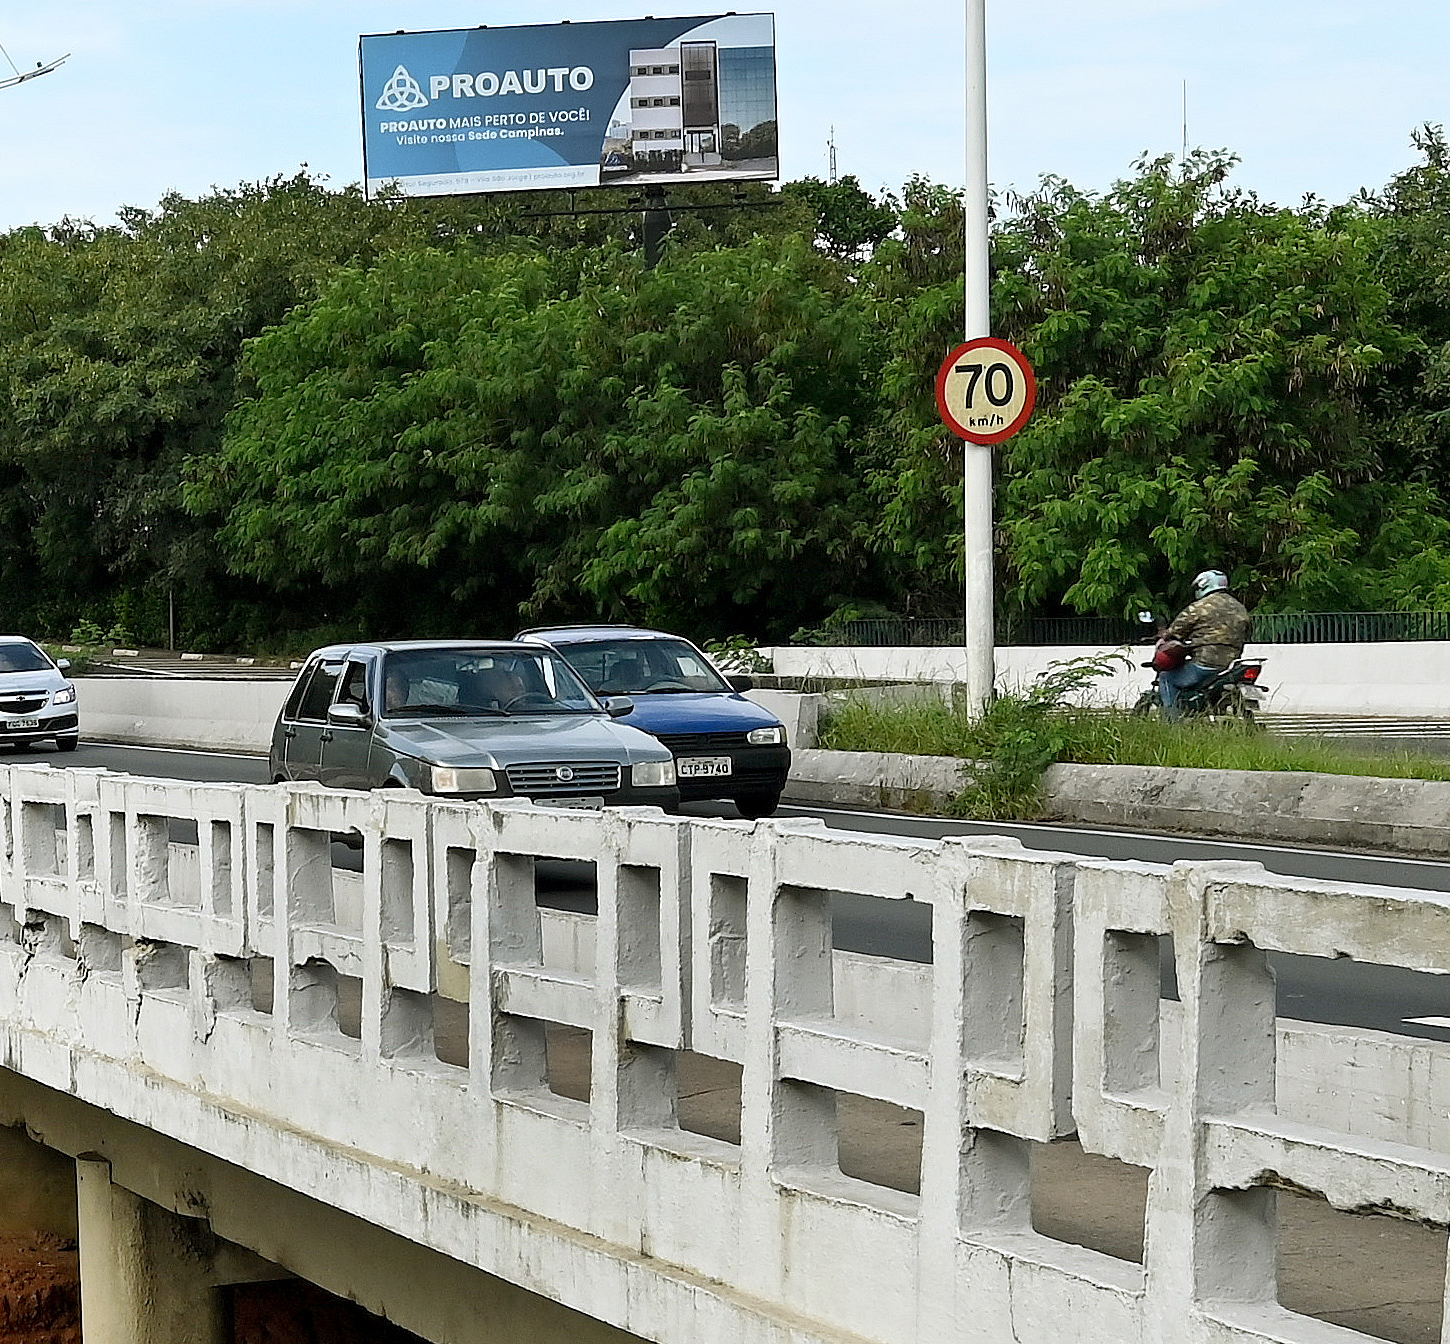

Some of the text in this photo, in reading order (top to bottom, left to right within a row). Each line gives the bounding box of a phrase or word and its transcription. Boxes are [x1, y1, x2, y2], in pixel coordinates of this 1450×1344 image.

[429, 66, 594, 100] PROAUTO
[380, 107, 590, 133] PROAUTO MAIS PERTO DE VOCÊ!
[396, 125, 565, 146] Visite nossa Sede Campinas.
[955, 362, 1014, 409] 70
[969, 413, 1004, 427] km/h
